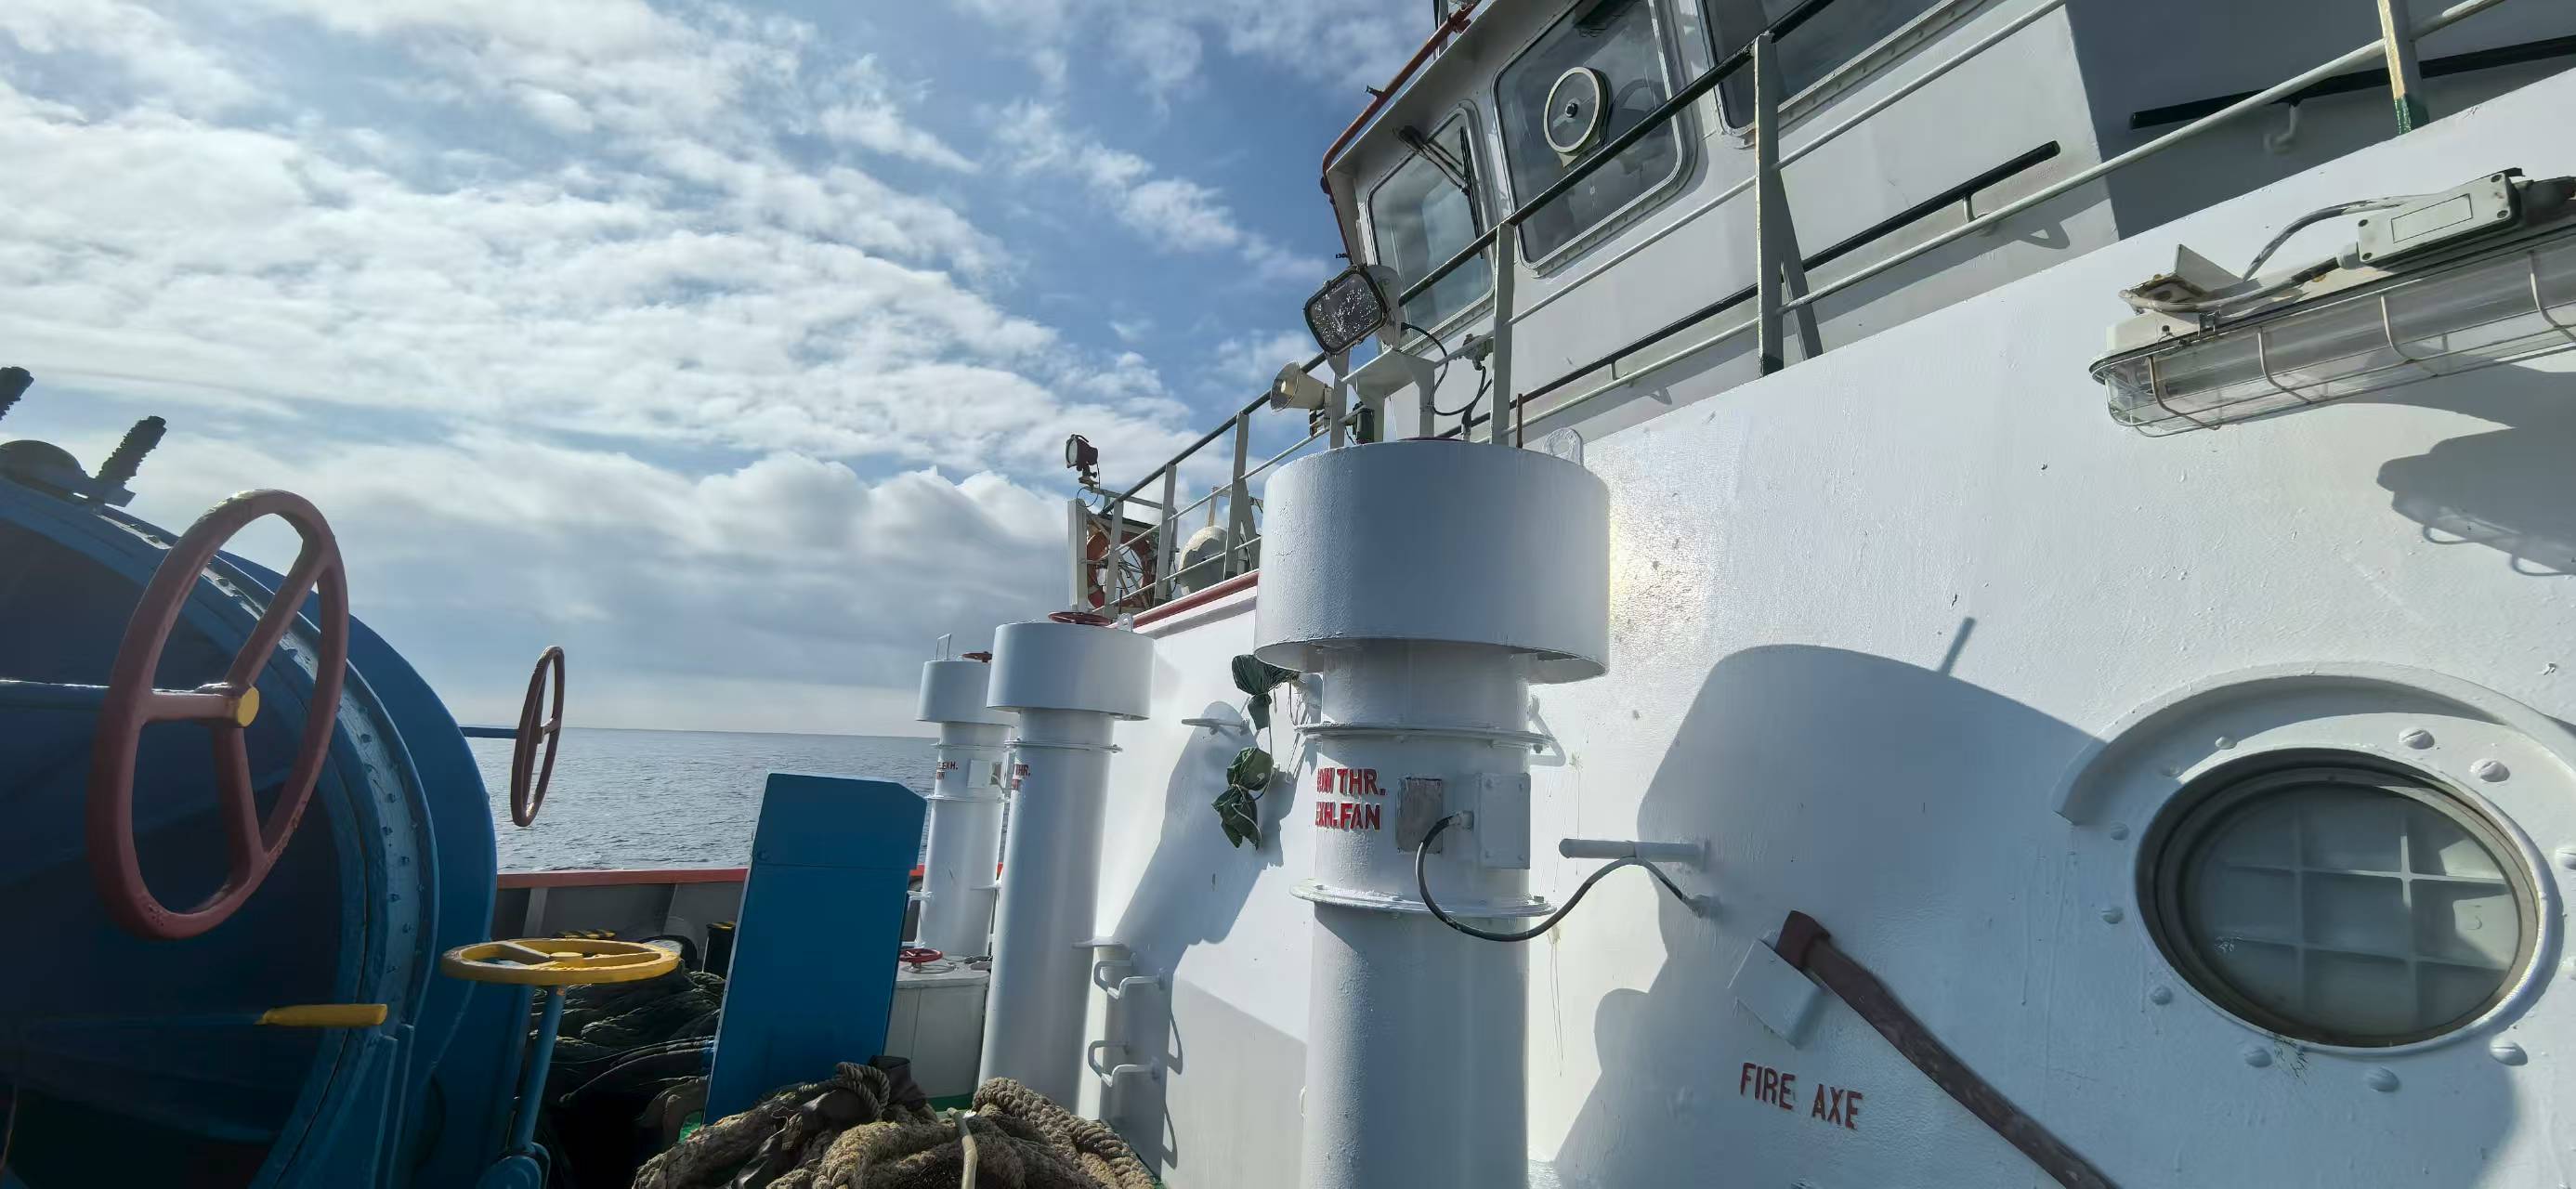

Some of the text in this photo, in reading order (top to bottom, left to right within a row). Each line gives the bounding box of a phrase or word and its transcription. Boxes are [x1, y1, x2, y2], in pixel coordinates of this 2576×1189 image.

[1337, 768, 1387, 796] THR.
[1740, 1062, 1863, 1130] FIRE AXE
